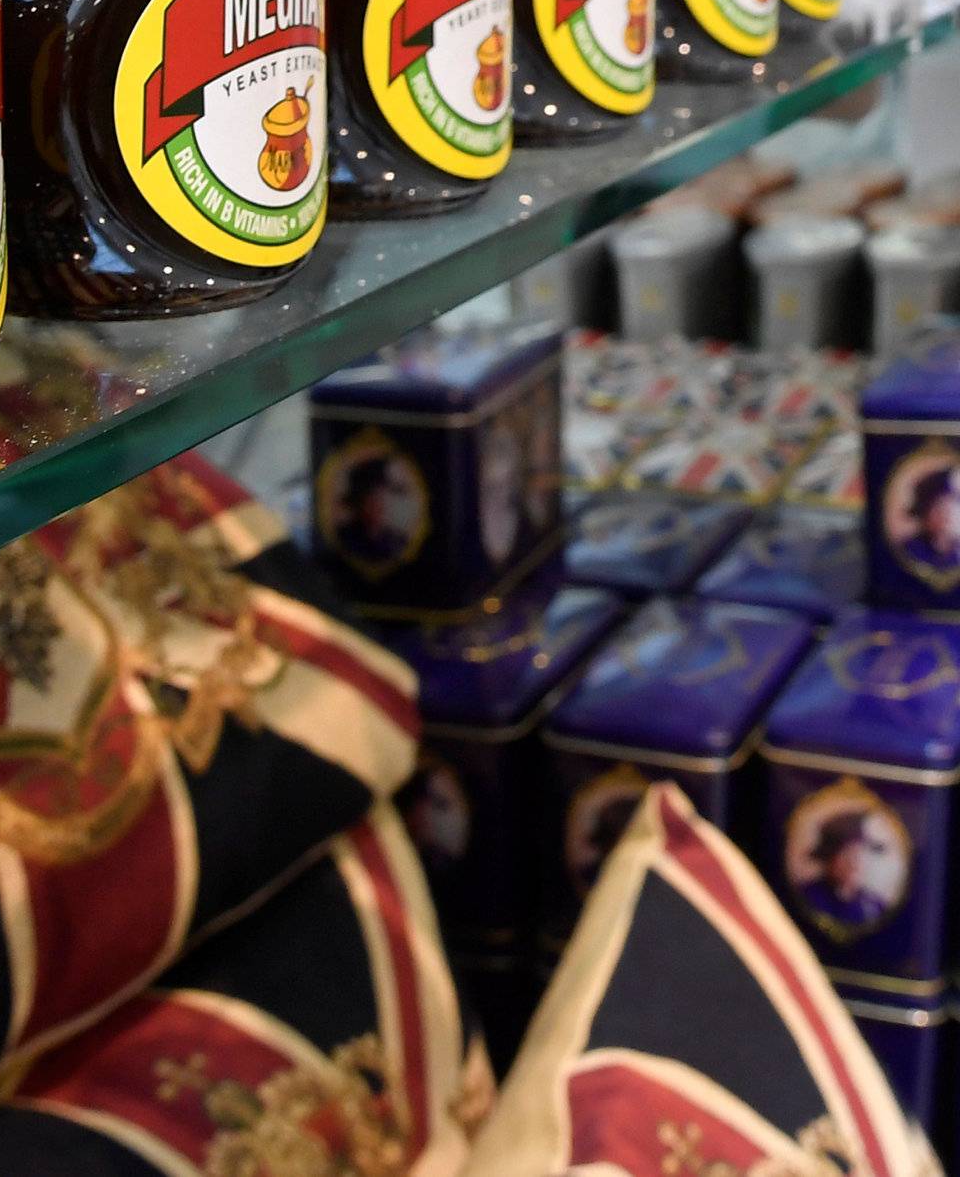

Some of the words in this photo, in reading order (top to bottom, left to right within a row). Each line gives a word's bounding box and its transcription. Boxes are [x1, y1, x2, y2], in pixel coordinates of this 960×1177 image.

[222, 61, 278, 97] YEAST
[174, 145, 209, 198] RICH
[201, 186, 225, 215] IN
[219, 199, 235, 223] B
[233, 205, 289, 238] VITAMINS
